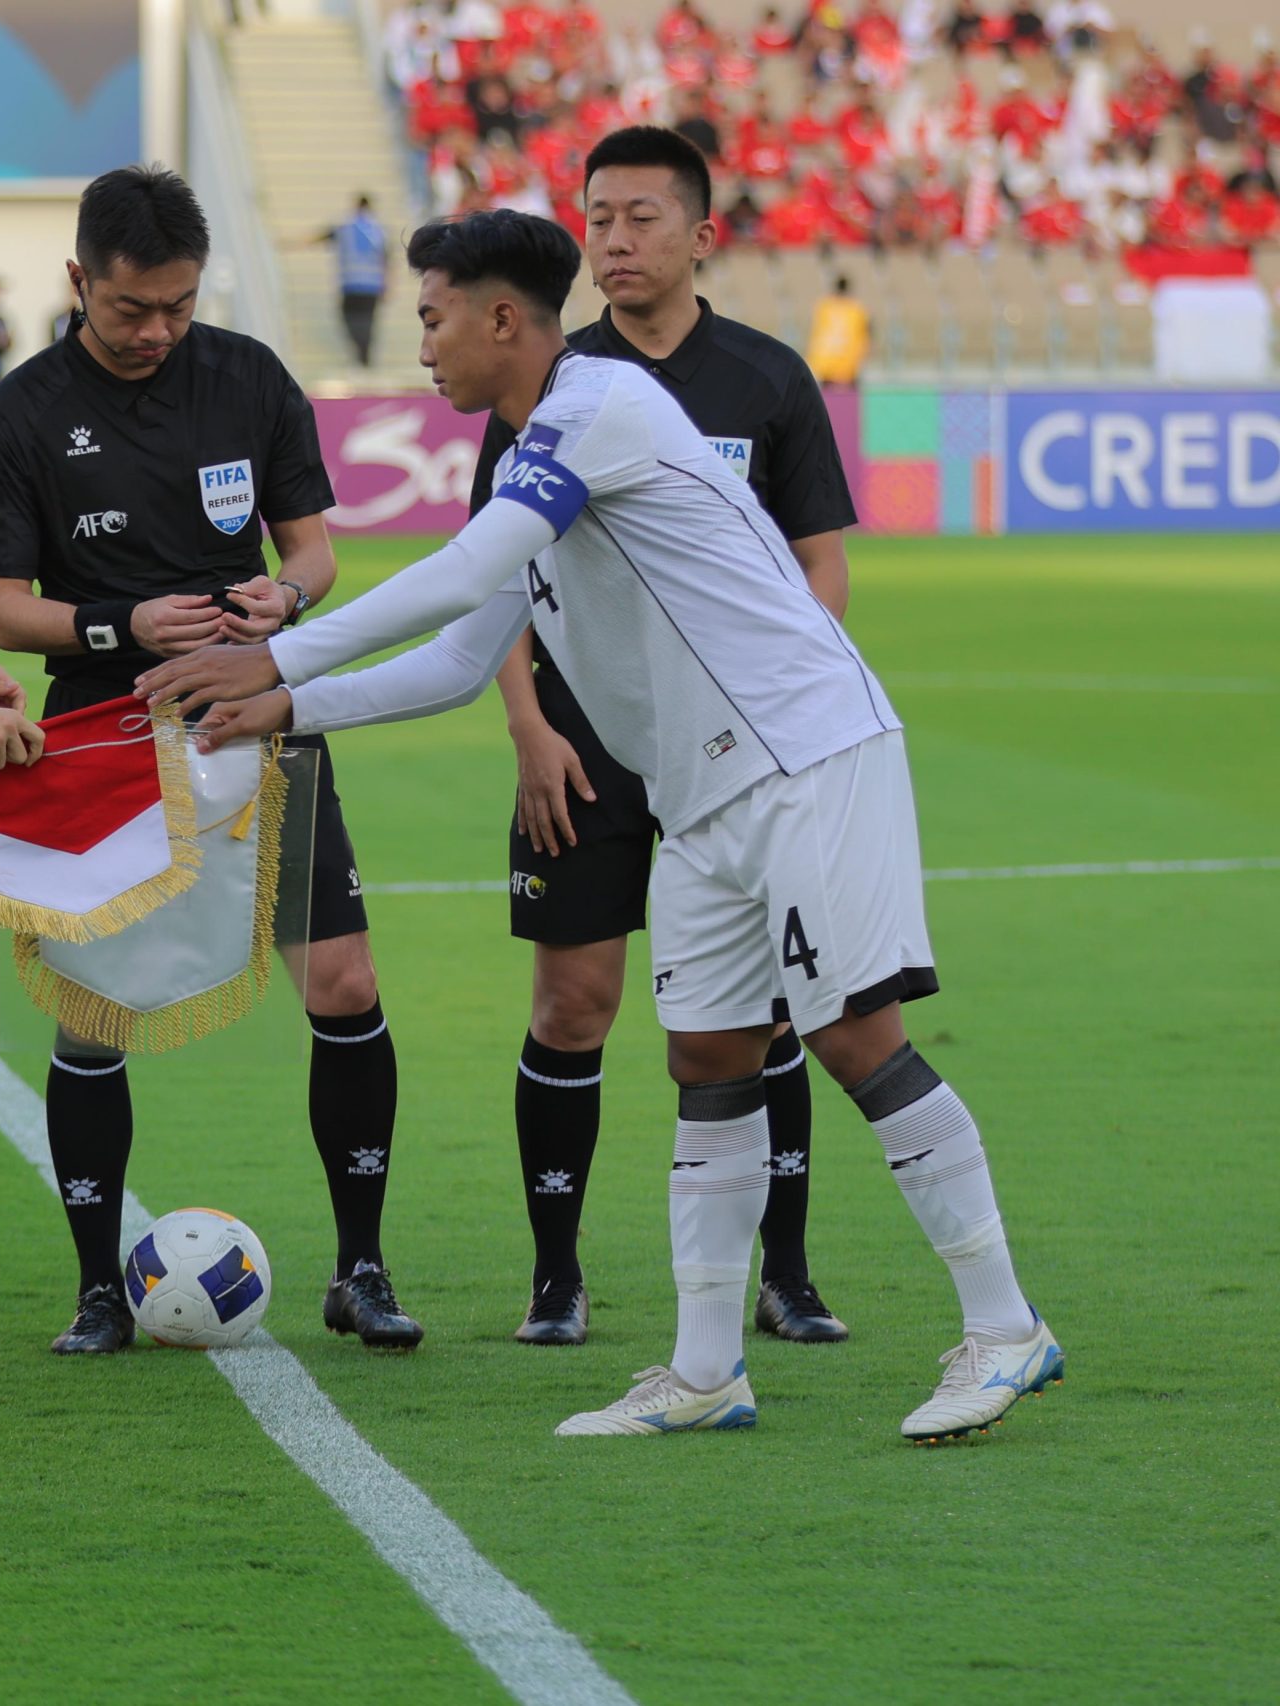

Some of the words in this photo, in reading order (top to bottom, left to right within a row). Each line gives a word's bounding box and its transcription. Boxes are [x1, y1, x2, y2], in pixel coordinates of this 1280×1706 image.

[67, 445, 101, 457] KELME
[709, 441, 746, 460] IFA
[204, 466, 247, 489] FIFA
[503, 461, 564, 501] AFC
[208, 493, 250, 509] REFEREE
[72, 510, 128, 540] AFC
[222, 518, 242, 529] 2025
[528, 558, 559, 614] 4
[783, 905, 819, 981] 4
[348, 1165, 385, 1175] KELME
[770, 1165, 806, 1176] KELME
[535, 1185, 573, 1194] KELME
[66, 1195, 102, 1206] KELME
